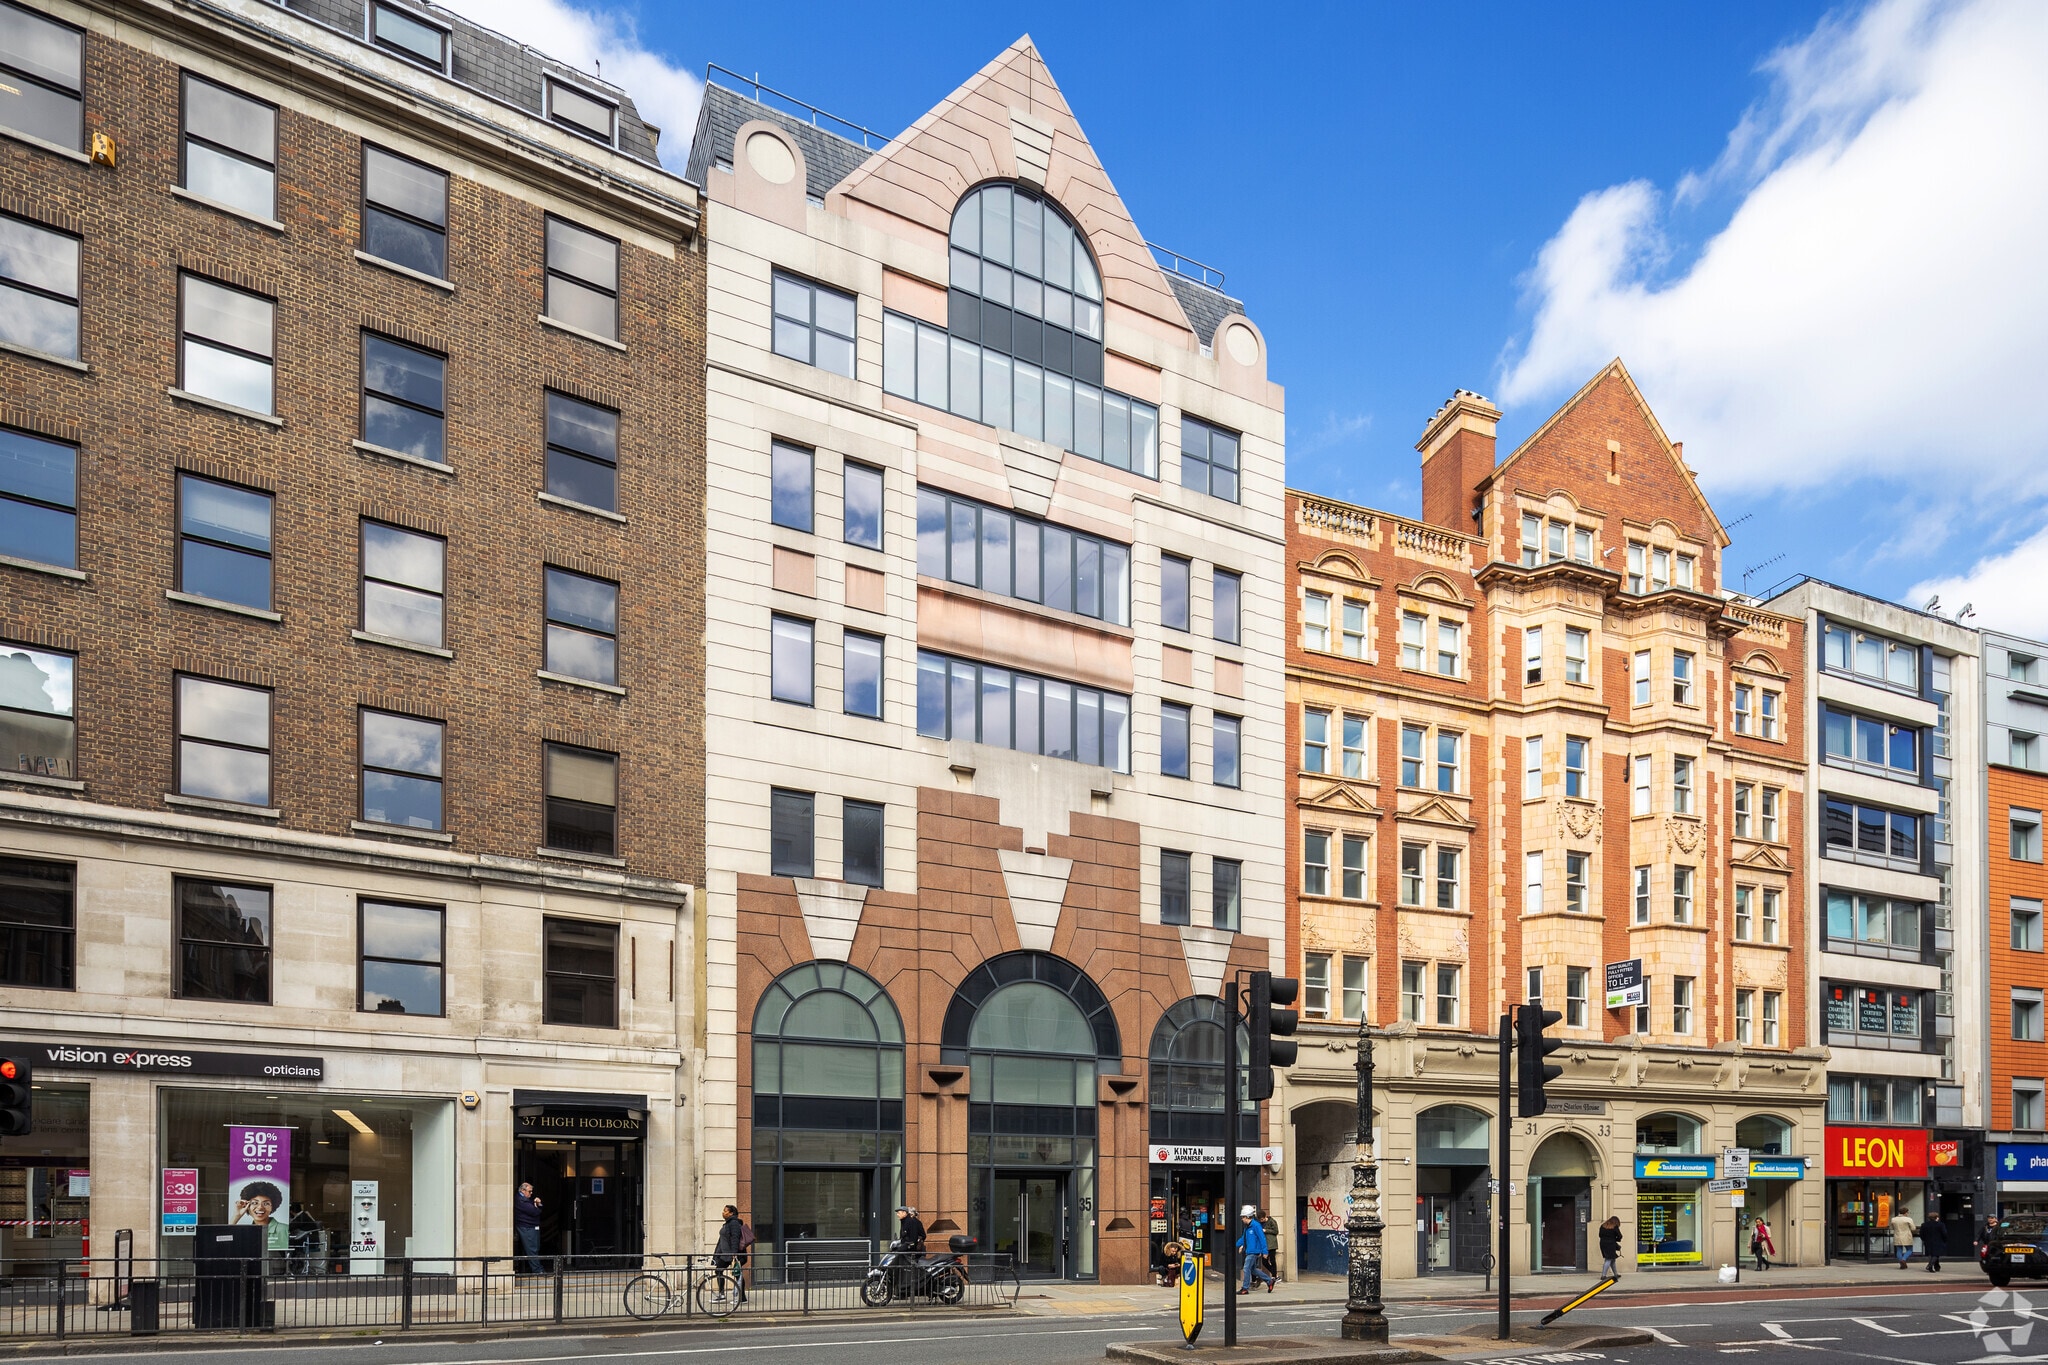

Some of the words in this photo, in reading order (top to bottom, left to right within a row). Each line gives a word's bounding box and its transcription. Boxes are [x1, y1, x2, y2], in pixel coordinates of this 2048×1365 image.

[1608, 979, 1618, 987] TO
[1619, 976, 1633, 985] LET
[47, 1046, 106, 1063] vision
[113, 1050, 192, 1068] express
[264, 1065, 320, 1076] opticians
[1563, 1102, 1582, 1111] Station
[1583, 1103, 1599, 1111] House
[522, 1116, 536, 1126] 37
[541, 1117, 574, 1127] HIGH
[579, 1118, 640, 1129] HOLBORN
[1525, 1122, 1538, 1136] 31
[1597, 1124, 1611, 1137] 33
[244, 1131, 277, 1144] 50%
[243, 1144, 278, 1157] OFF
[1174, 1147, 1203, 1156] KINTAN
[1843, 1137, 1904, 1168] LEON
[1931, 1143, 1955, 1151] LEON
[1203, 1155, 1215, 1163] BBQ
[166, 1183, 195, 1195] £39
[973, 1197, 986, 1212] 35
[1079, 1197, 1091, 1212] 35
